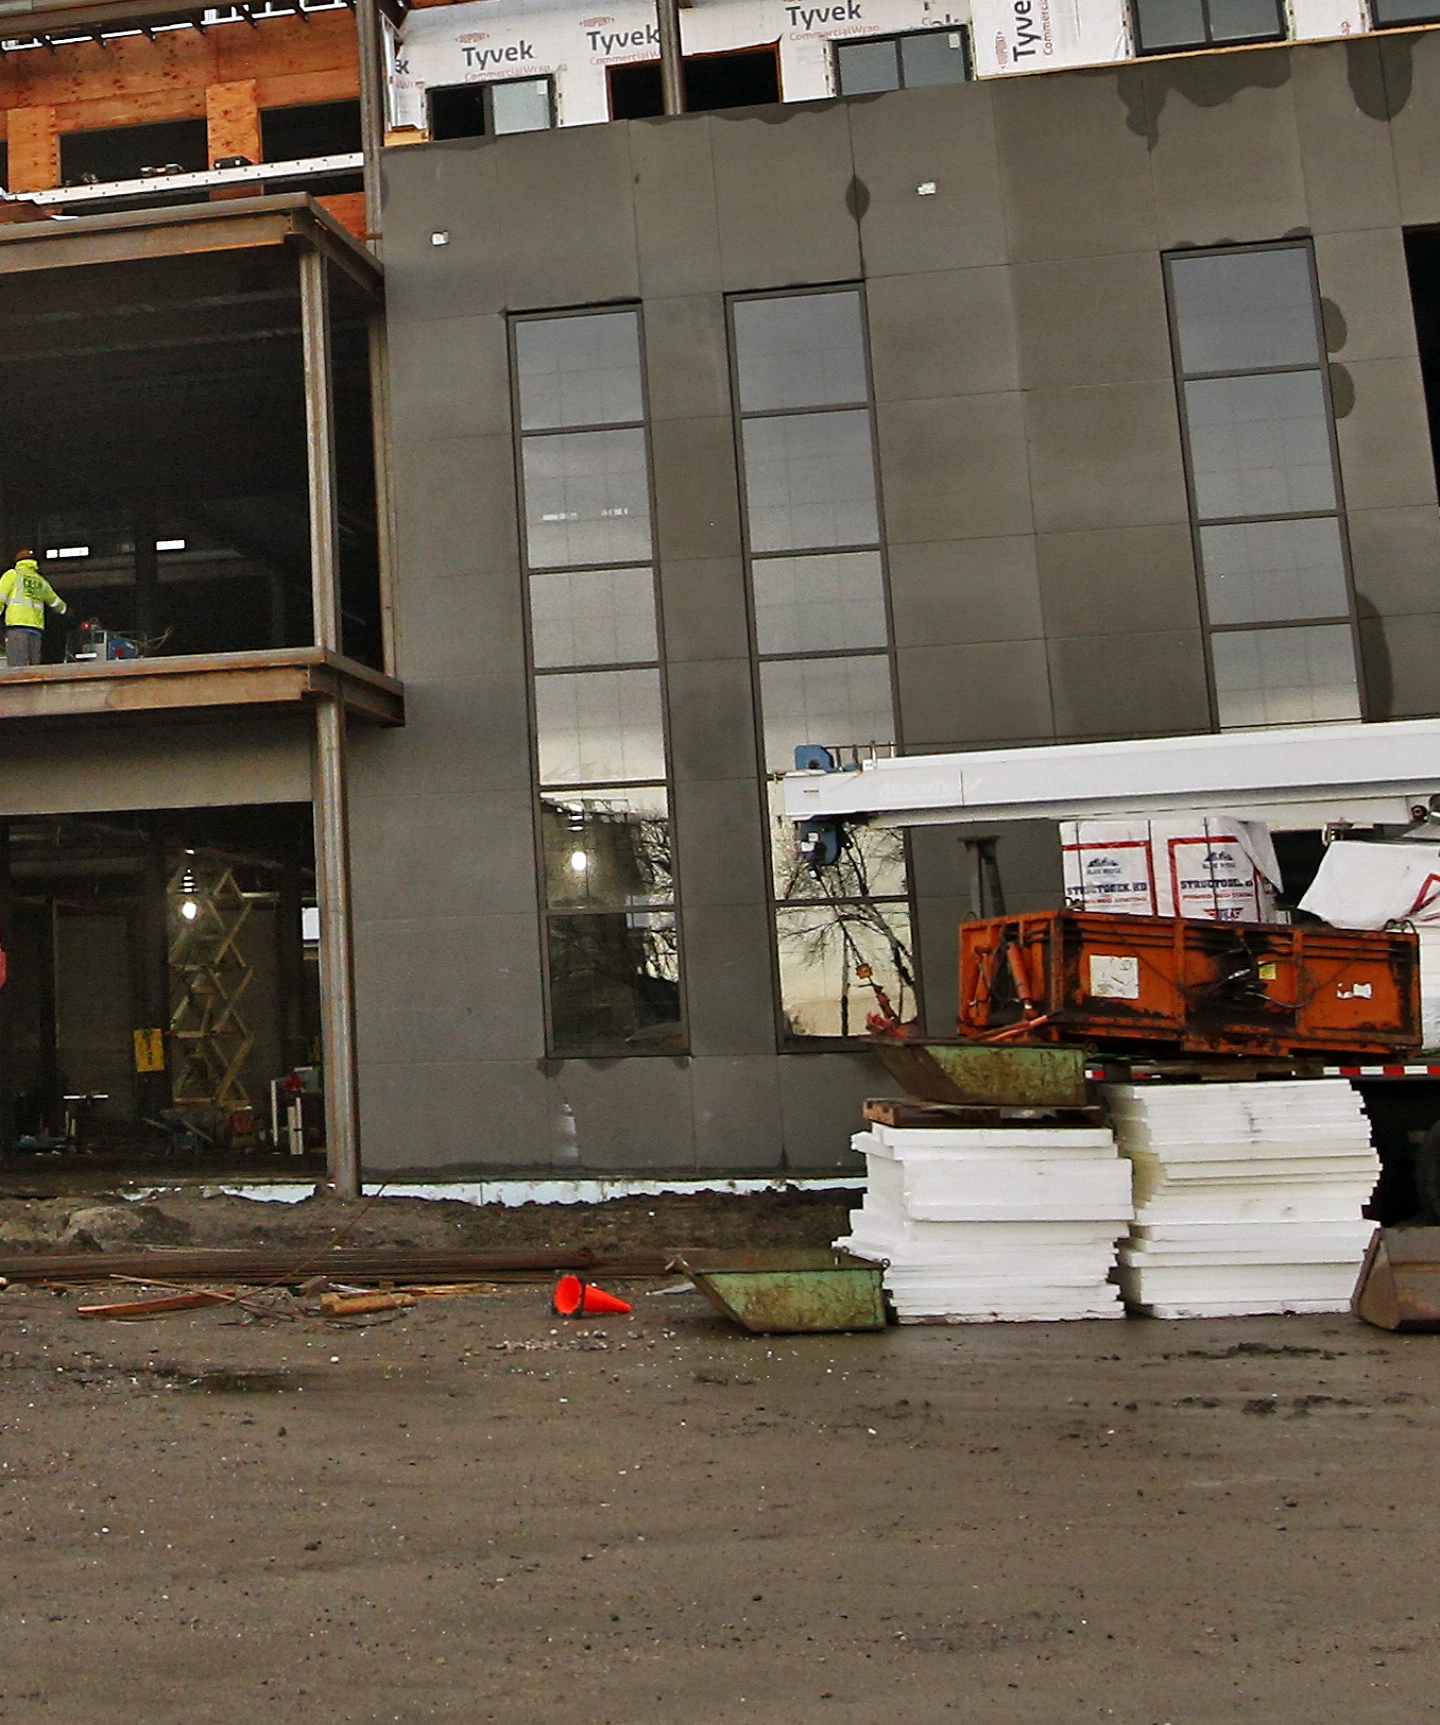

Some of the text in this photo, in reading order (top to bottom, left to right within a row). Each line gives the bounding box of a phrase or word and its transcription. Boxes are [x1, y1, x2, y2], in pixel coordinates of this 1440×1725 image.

[785, 0, 862, 30] Tyvek
[587, 25, 660, 54] Tyvek
[462, 41, 534, 70] Tyvek
